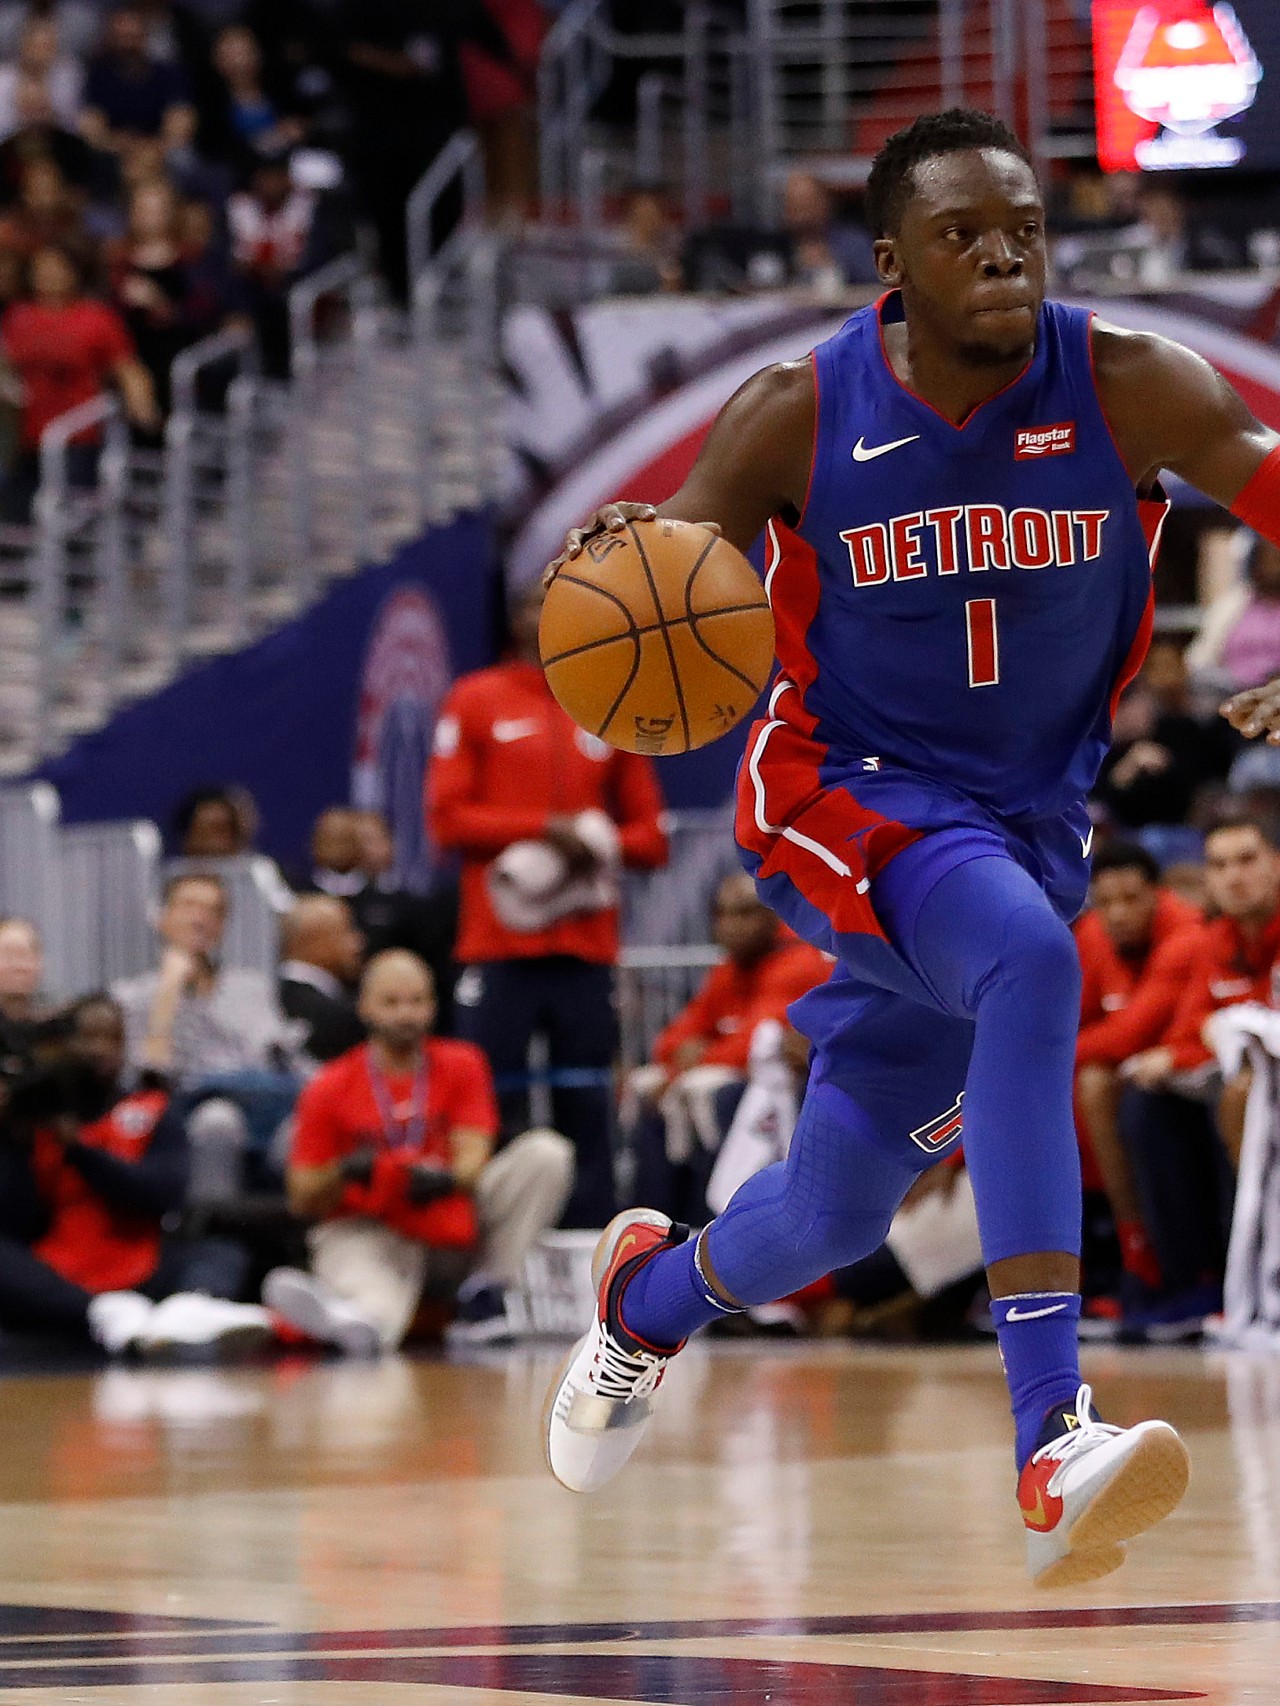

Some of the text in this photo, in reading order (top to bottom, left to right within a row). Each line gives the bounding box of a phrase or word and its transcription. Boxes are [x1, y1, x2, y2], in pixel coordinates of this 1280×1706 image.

[1017, 428, 1071, 446] Flagstar
[839, 503, 1110, 588] DETROIT
[965, 598, 999, 688] 1
